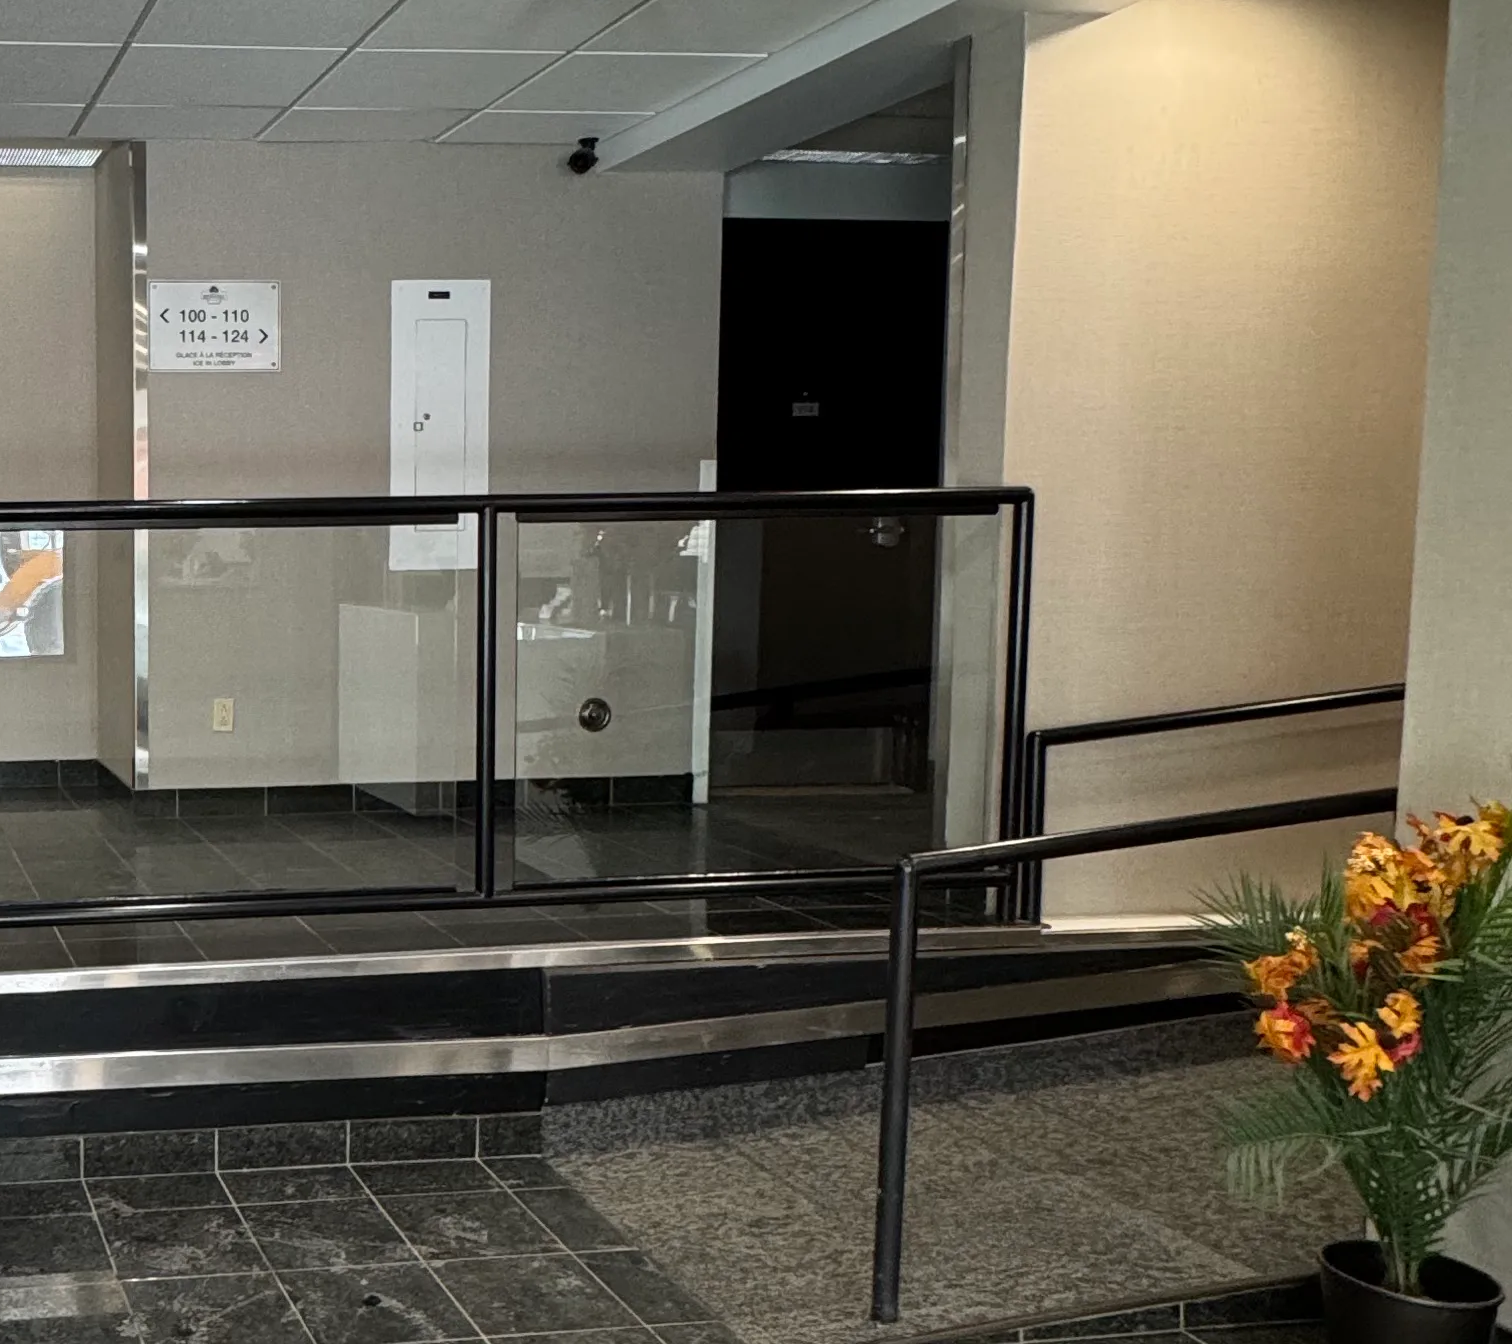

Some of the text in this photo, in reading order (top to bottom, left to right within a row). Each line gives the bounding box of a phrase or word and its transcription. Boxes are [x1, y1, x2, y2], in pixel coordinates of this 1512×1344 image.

[179, 309, 206, 323] 100
[223, 309, 250, 323] 110
[179, 330, 206, 343] 114
[223, 330, 249, 343] 124
